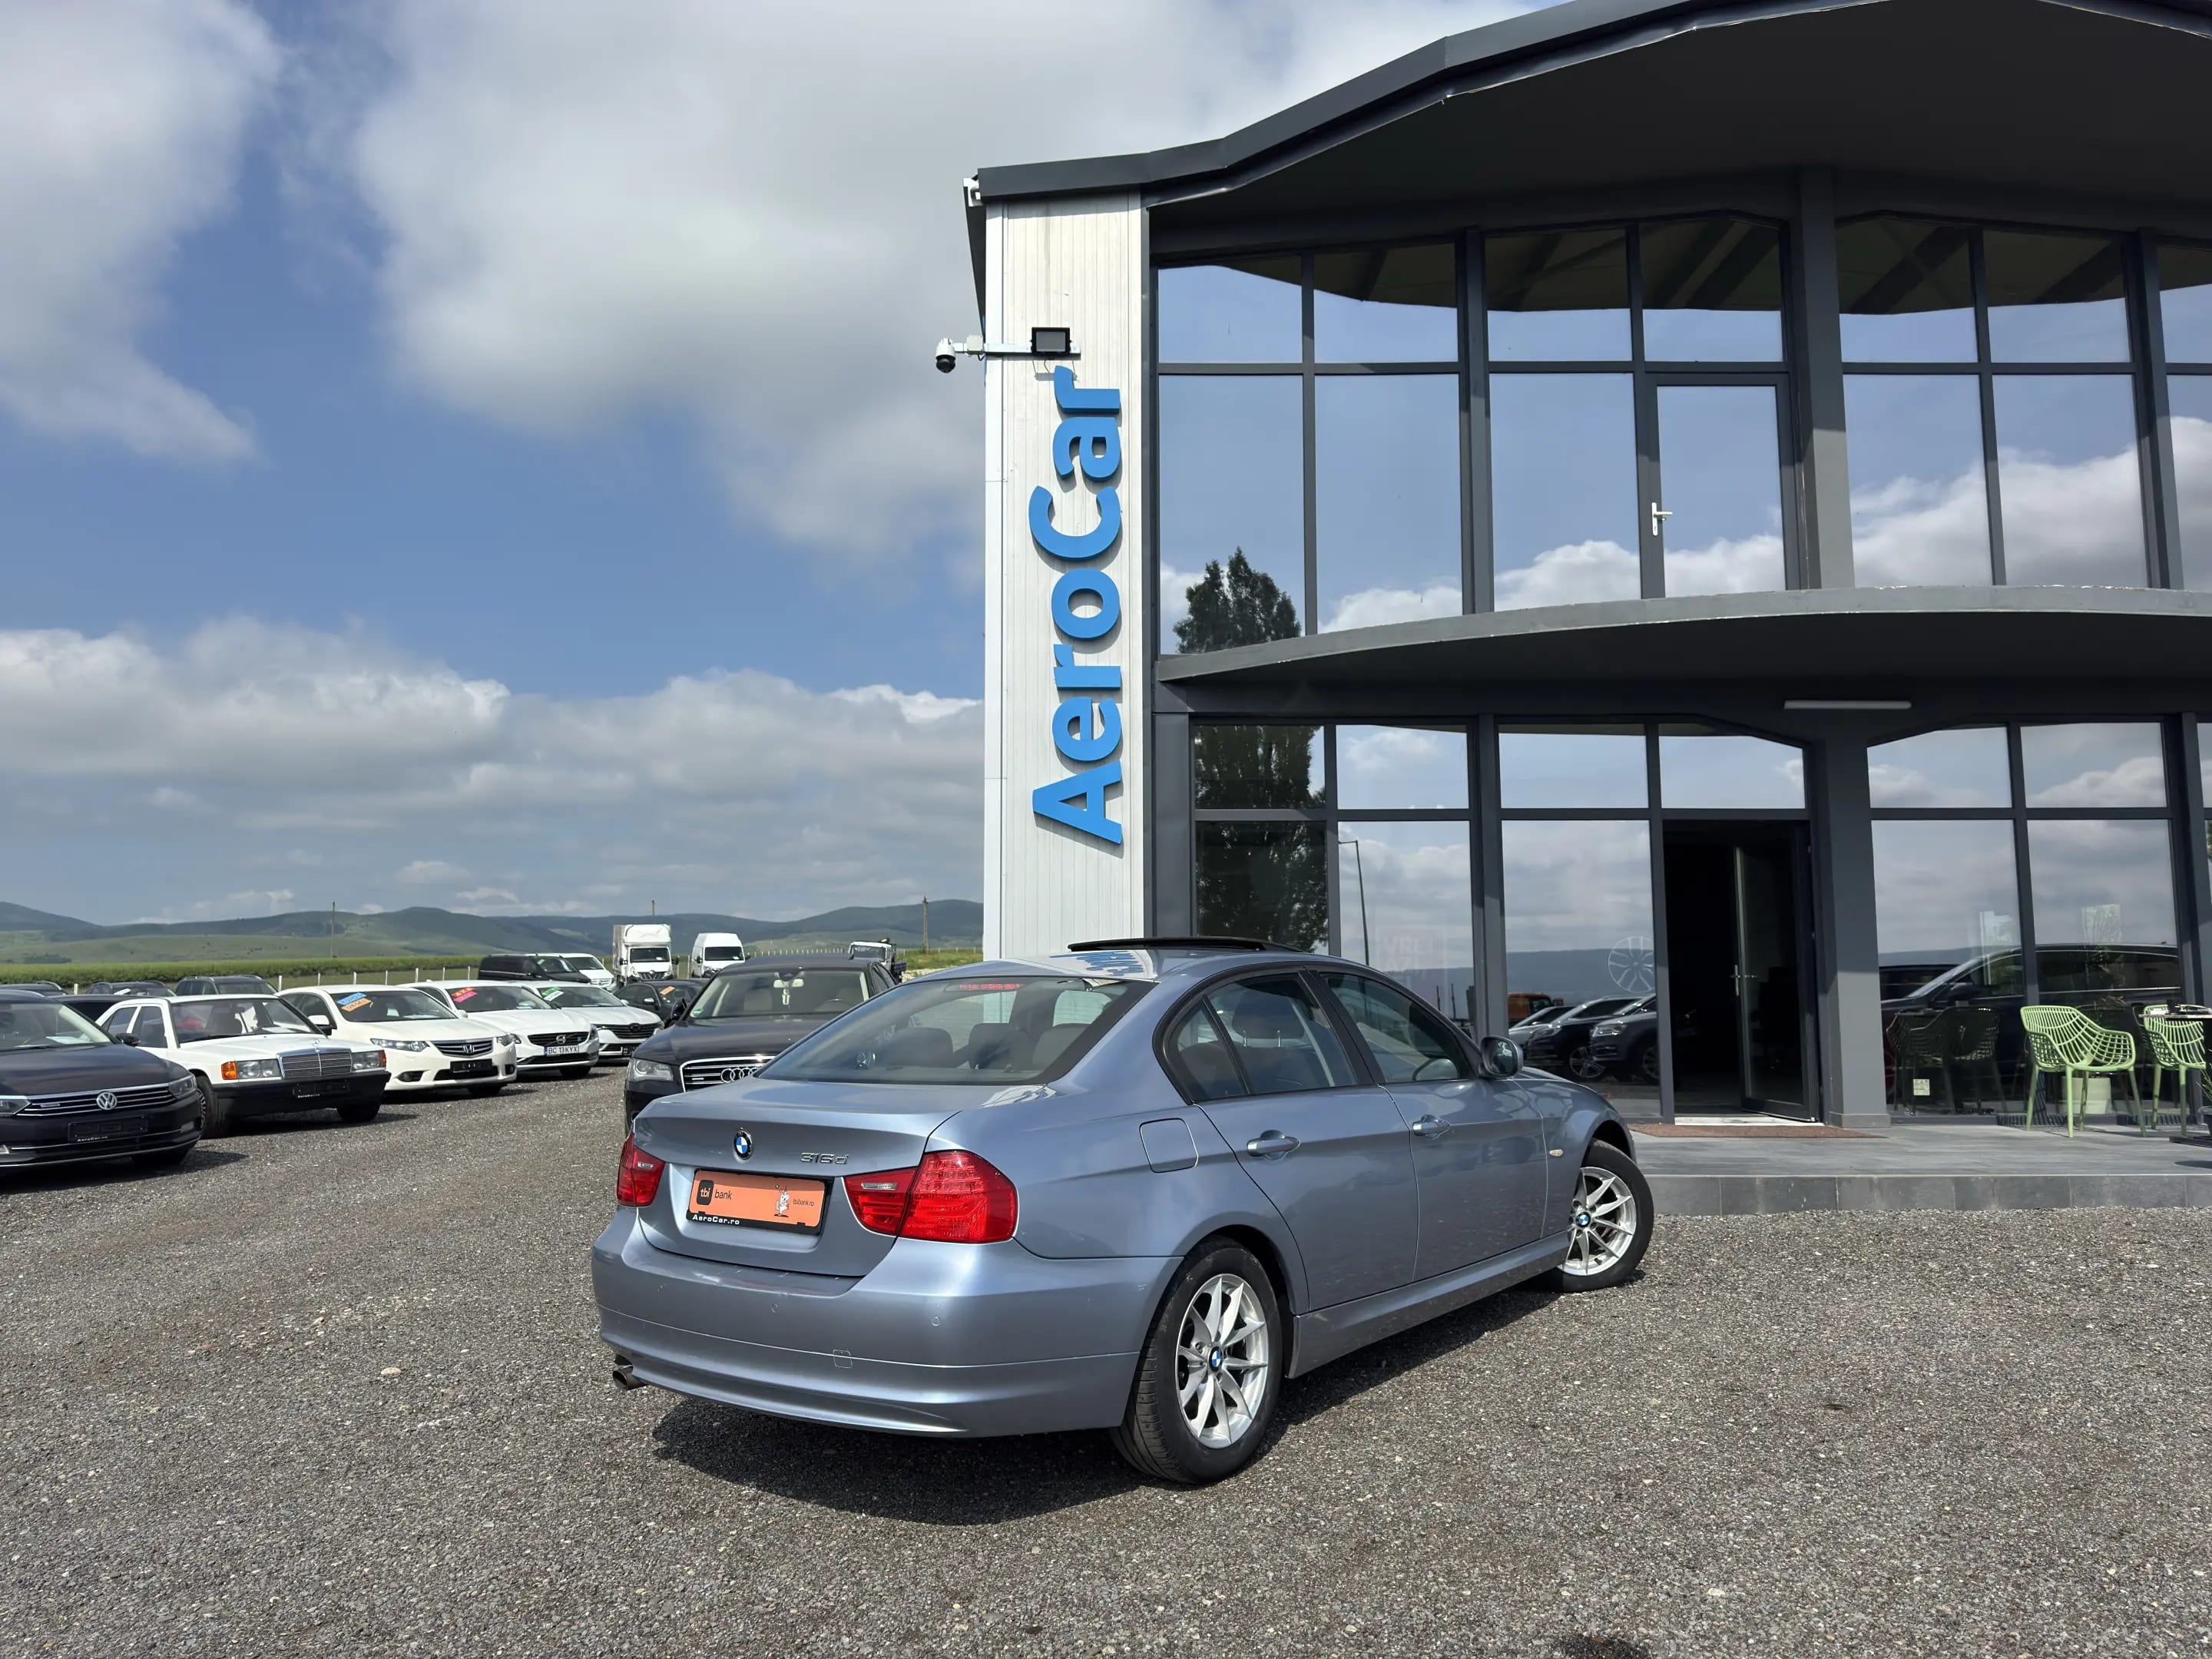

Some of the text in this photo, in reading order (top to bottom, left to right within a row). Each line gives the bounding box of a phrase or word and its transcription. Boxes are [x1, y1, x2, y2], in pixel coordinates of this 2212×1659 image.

[1028, 365, 1122, 845] AeroCar
[800, 1151, 849, 1165] 316d
[700, 1187, 733, 1200] tbi bank
[793, 1198, 815, 1207] tbibank.ro
[692, 1214, 740, 1225] AeroCar.ro
